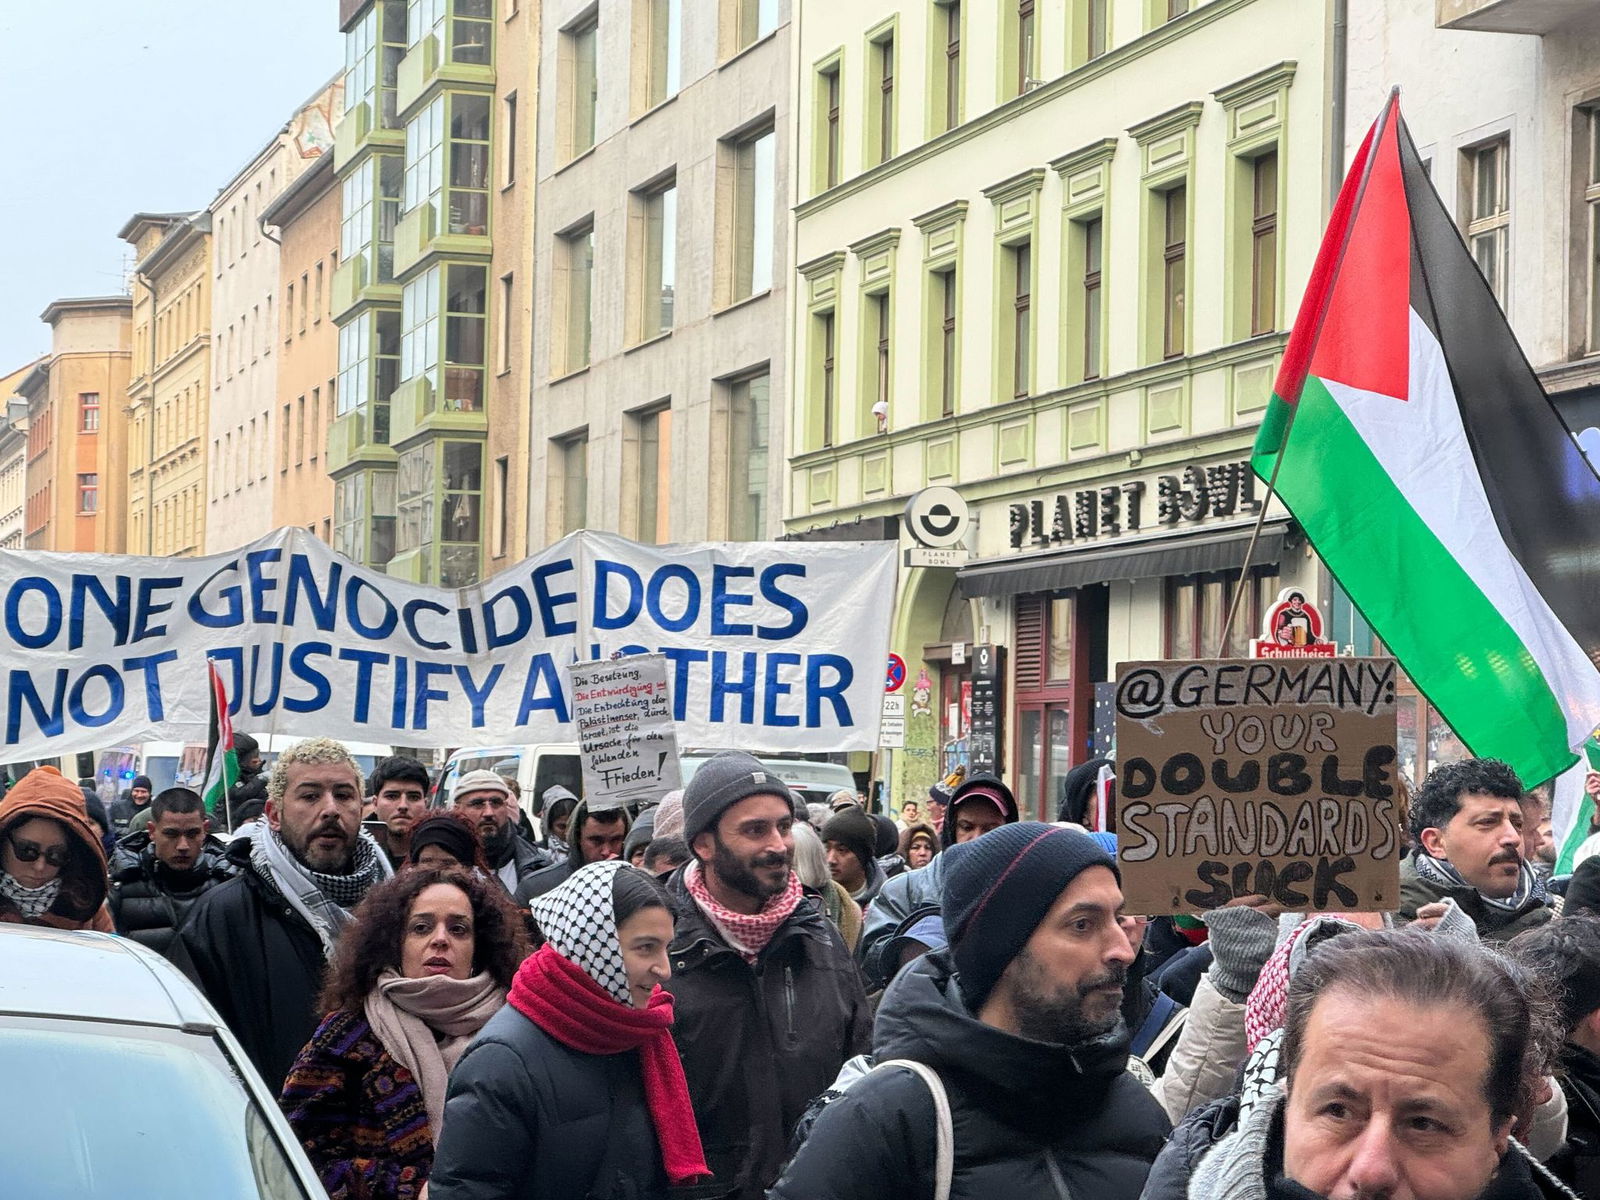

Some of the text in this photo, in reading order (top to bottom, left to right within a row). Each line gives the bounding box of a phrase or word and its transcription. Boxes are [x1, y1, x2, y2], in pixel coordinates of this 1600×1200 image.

[1010, 461, 1263, 548] PLANET BOWL
[4, 548, 809, 654] ONE GENOCIDE DOES
[1261, 646, 1331, 659] Schultheiss
[5, 642, 854, 744] NOT JUSTIFY ATHER
[574, 676, 588, 687] Die
[575, 692, 589, 702] Die
[1116, 662, 1395, 719] @GERMANY:
[577, 694, 667, 716] Die Entrechtung der
[624, 723, 639, 732] die
[646, 730, 664, 740] den
[1201, 711, 1337, 755] YOUR
[591, 749, 639, 770] fehlenden
[597, 751, 668, 789] Frieden!
[1122, 745, 1397, 799] DOUBLE
[1121, 795, 1394, 862] STANDARDS
[1185, 857, 1358, 909] SUCK
